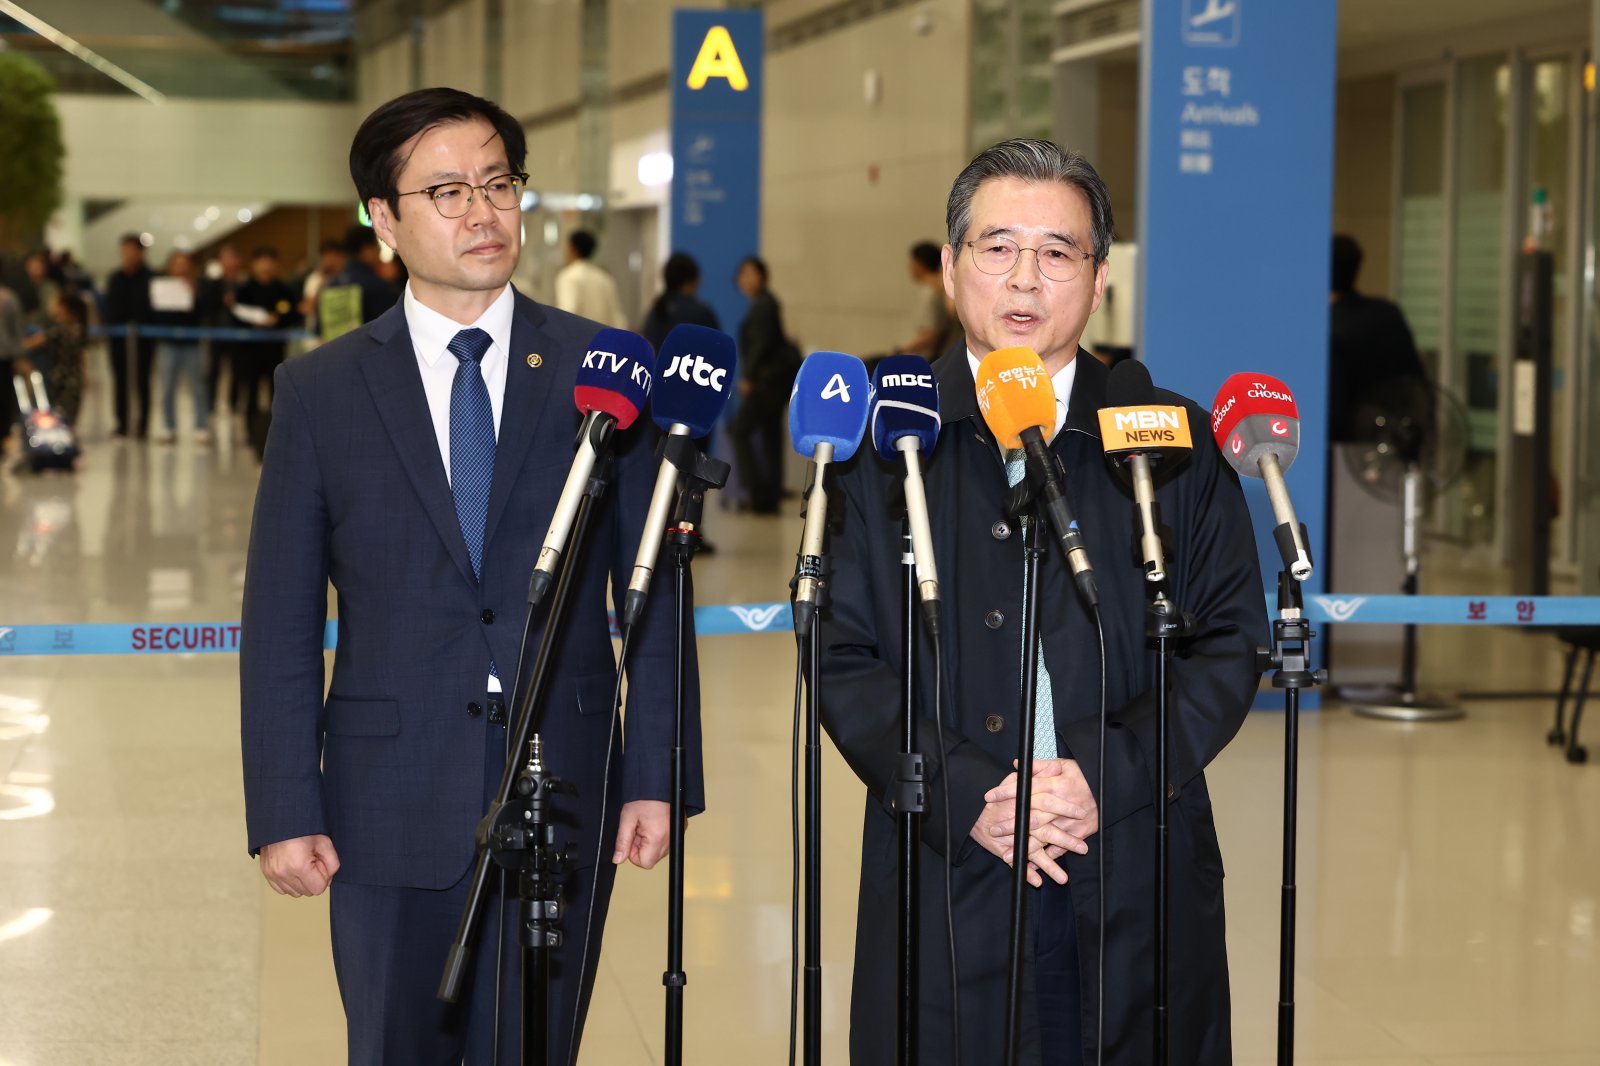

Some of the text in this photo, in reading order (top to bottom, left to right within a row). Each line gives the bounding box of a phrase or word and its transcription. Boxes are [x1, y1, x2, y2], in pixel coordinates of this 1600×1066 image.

[686, 25, 749, 92] A
[582, 350, 629, 373] KTV
[881, 373, 933, 389] MBC
[998, 364, 1047, 383] 연합뉴스
[1017, 376, 1038, 390] TV
[1252, 382, 1267, 390] TV
[1247, 389, 1293, 403] CHOSUN
[1114, 408, 1180, 430] MBN
[1212, 396, 1236, 432] CHOSUN
[1125, 429, 1175, 443] NEWS
